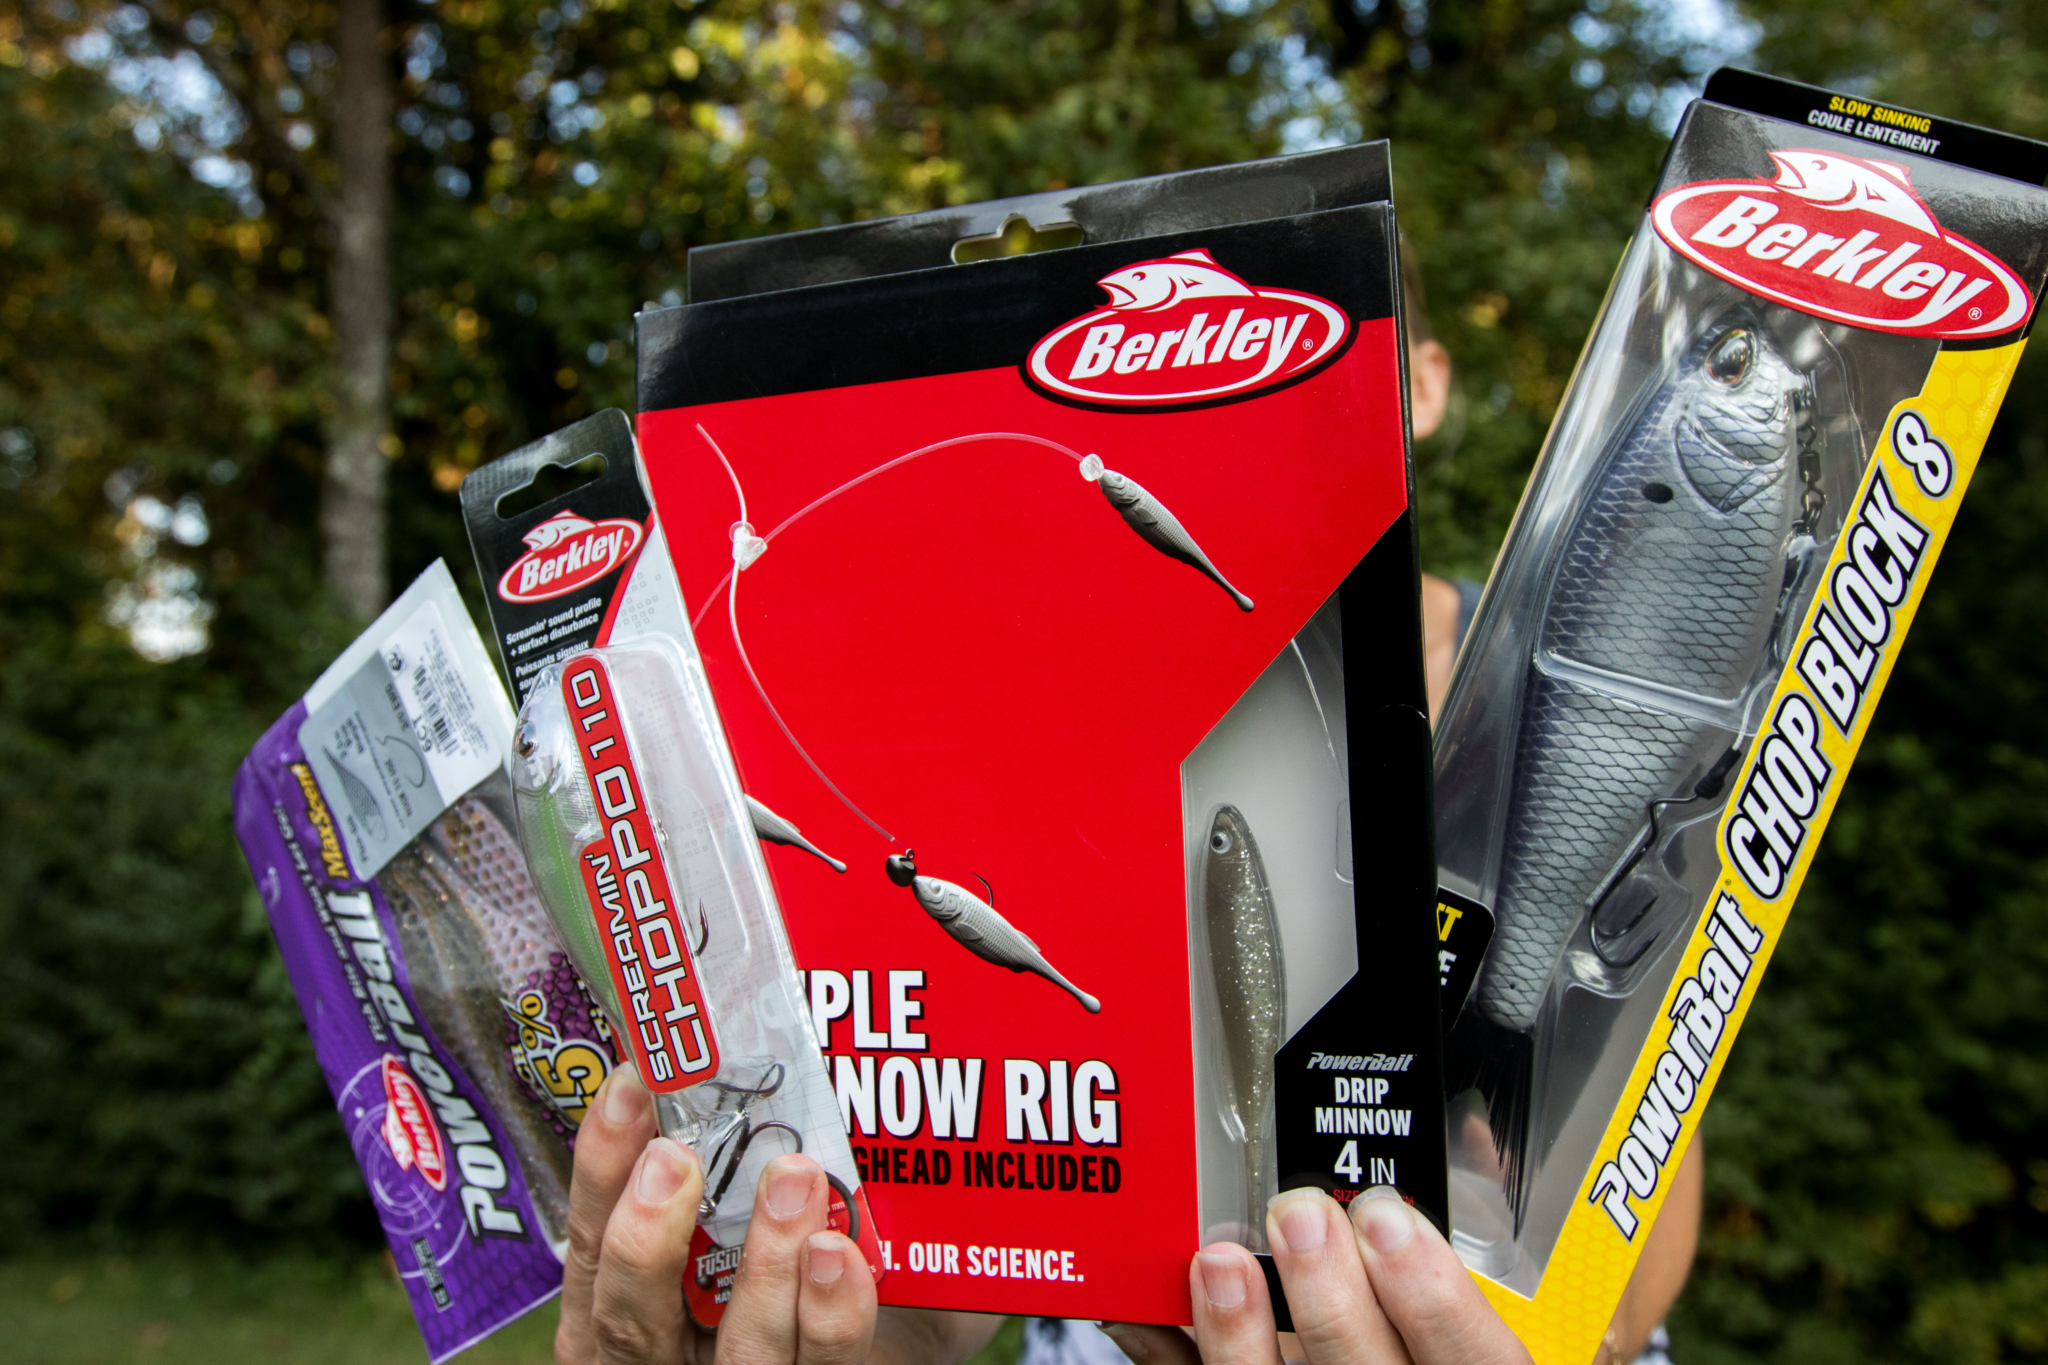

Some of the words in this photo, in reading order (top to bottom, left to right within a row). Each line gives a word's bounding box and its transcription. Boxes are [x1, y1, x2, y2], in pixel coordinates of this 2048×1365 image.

[1808, 109, 1855, 133] COULE
[1855, 120, 1941, 155] LENTEMENT
[1828, 96, 1872, 119] SLOW
[1872, 105, 1932, 134] SINKING
[1690, 195, 1993, 322] Berkley
[1068, 308, 1310, 384] Berkley
[518, 528, 624, 594] Berkley
[506, 617, 547, 645] Screamin'
[548, 606, 574, 628] sound
[575, 597, 602, 617] profile
[517, 635, 549, 655] surface
[549, 613, 599, 642] disturbance
[515, 653, 556, 678] Puissants
[556, 639, 589, 662] signaux
[569, 667, 618, 761] 110
[1589, 888, 1765, 1242] PowerBait
[1726, 693, 1834, 903] CHOP
[1799, 466, 1931, 735] BLOCK
[1893, 411, 1954, 497] 8
[594, 764, 713, 1076] CHOPPO
[585, 853, 675, 1083] SCREAMIN'
[803, 969, 927, 1050] PLE
[326, 890, 523, 1238] PowerBait
[1307, 1052, 1414, 1072] PowerBait
[830, 1055, 983, 1139] NOW
[1003, 1058, 1118, 1145] RIG
[1334, 1077, 1390, 1105] DRIP
[389, 1069, 440, 1171] Berkley
[1315, 1107, 1412, 1137] MINNOW
[853, 1146, 952, 1186] GHEAD
[963, 1150, 1122, 1194] INCLUDED
[1334, 1140, 1363, 1184] 4
[1371, 1157, 1396, 1186] IN
[908, 1242, 960, 1275] OUR
[967, 1245, 1085, 1283] SCIENCE.
